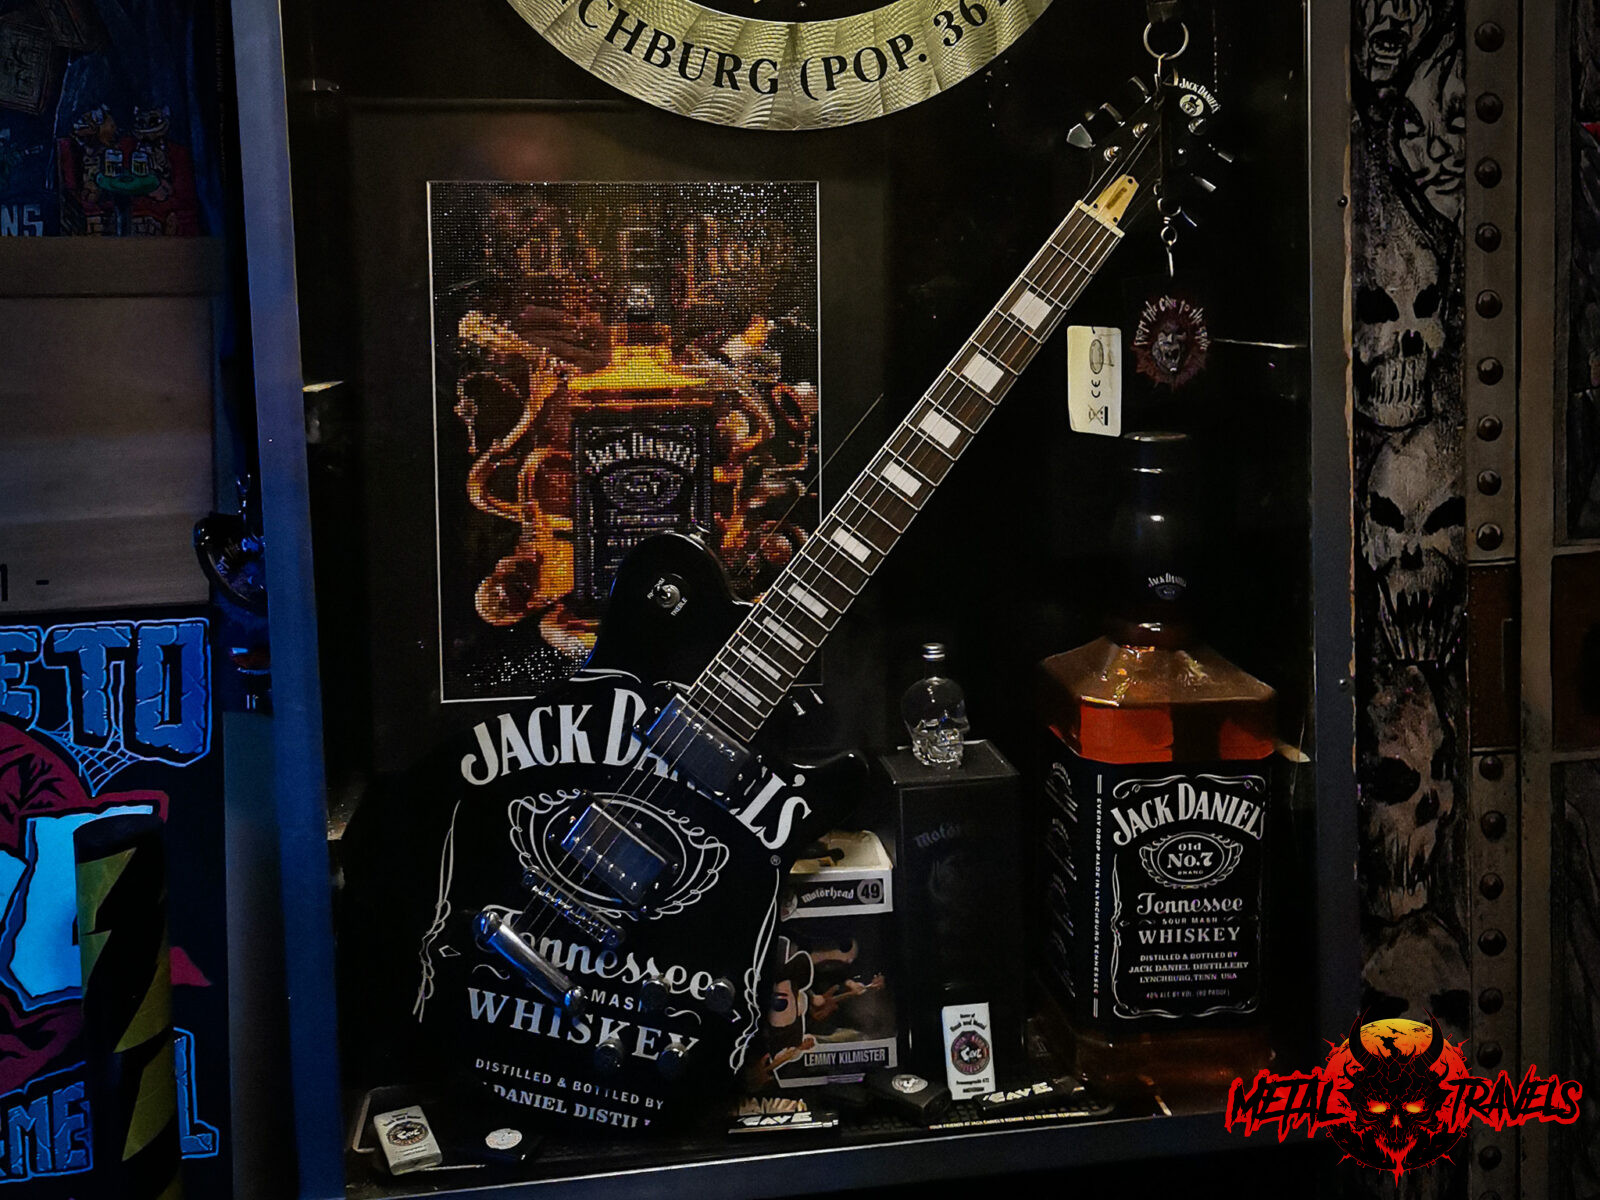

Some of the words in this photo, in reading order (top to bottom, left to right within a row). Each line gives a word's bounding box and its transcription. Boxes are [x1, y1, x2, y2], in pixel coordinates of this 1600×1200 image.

[563, 0, 779, 95] CHBURG
[800, 34, 928, 101] (POP.
[933, 0, 1007, 47] 36
[460, 702, 596, 786] JACK
[1110, 793, 1175, 846] JACK
[860, 881, 881, 900] 49
[1136, 892, 1244, 916] Tennessee
[1162, 916, 1187, 926] SOUR
[1191, 915, 1218, 926] MASH
[1138, 926, 1241, 945] WHISKEY
[803, 1051, 837, 1067] LEMMY
[839, 1047, 887, 1065] KILMISTER
[475, 1057, 552, 1085] DISTILLED
[556, 1076, 568, 1090] &
[644, 1097, 665, 1111] BY
